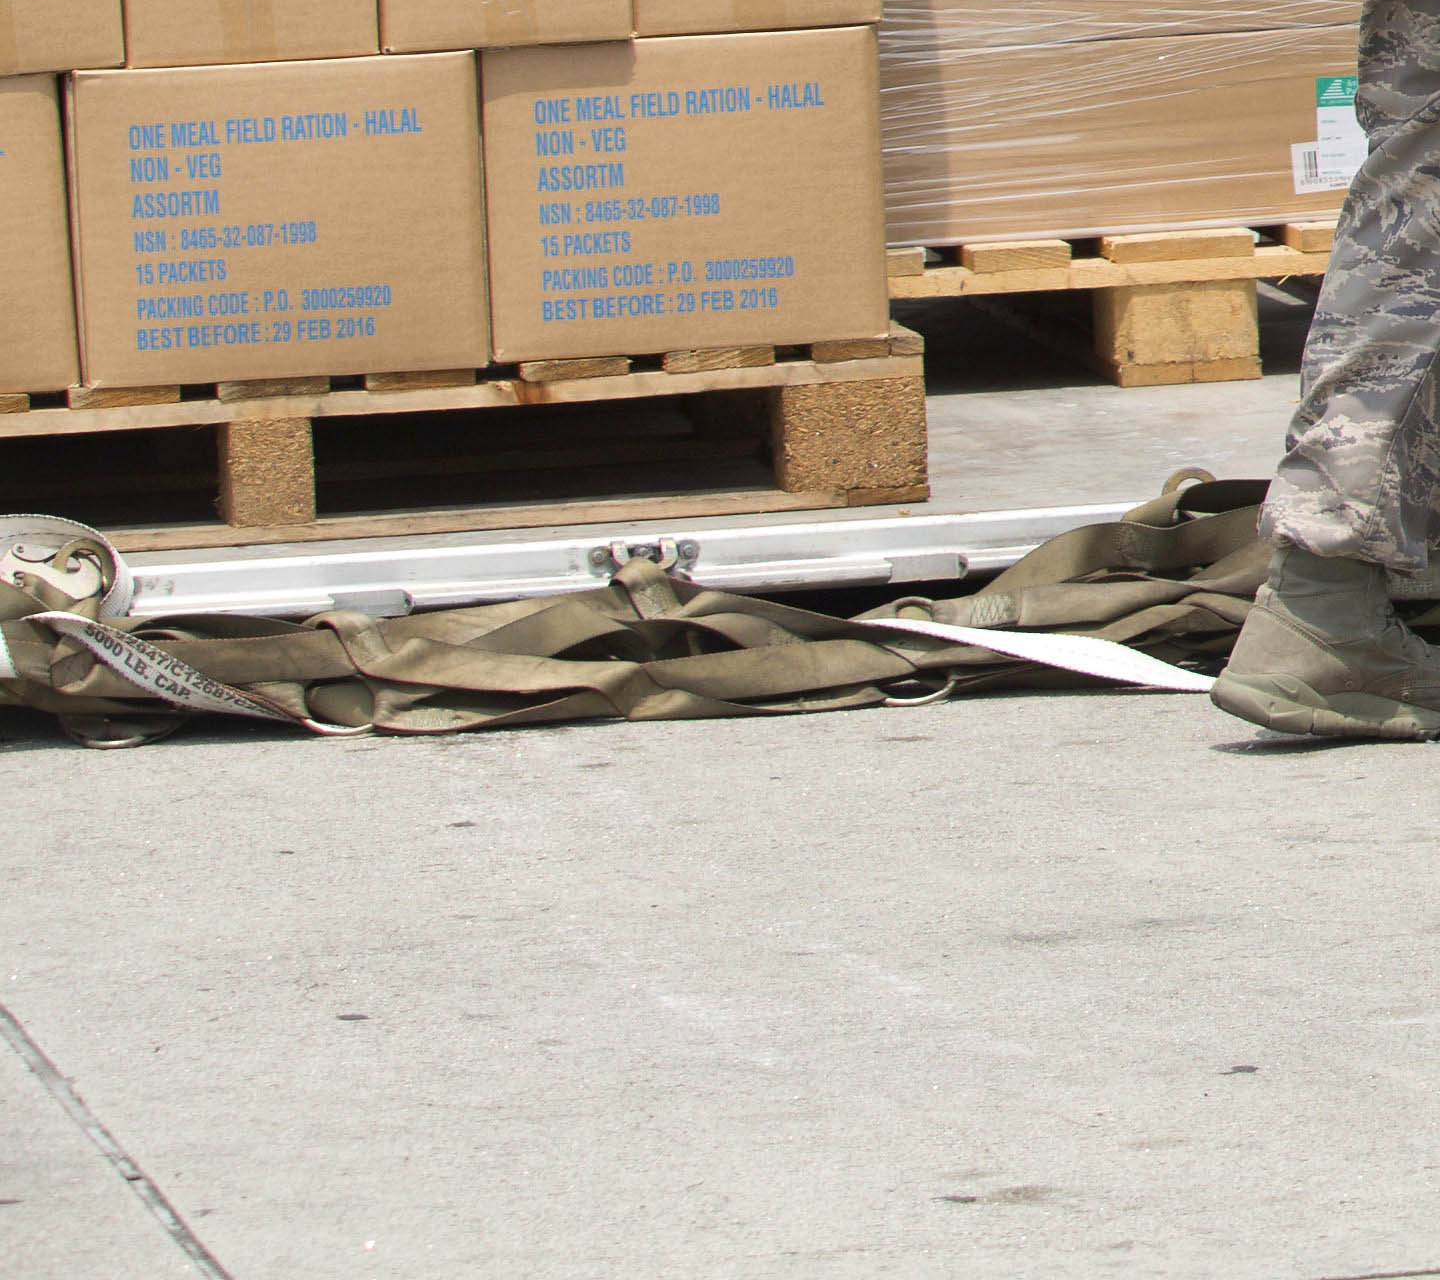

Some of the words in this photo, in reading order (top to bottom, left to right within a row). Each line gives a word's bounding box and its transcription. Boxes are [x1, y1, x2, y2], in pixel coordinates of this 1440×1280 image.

[533, 98, 571, 125] ONE
[574, 95, 626, 121] MEAL
[629, 91, 679, 118] FIELD
[683, 87, 750, 115] RATION
[766, 83, 825, 109] HALAL
[128, 123, 166, 151] ONE
[170, 121, 222, 148] MEAL
[225, 116, 276, 145] FIELD
[279, 112, 347, 141] RATION
[363, 108, 423, 135] HALAL
[535, 130, 575, 156] NON
[591, 126, 628, 153] VEG
[130, 156, 170, 183] NON
[185, 152, 222, 180] VEG
[537, 162, 625, 193] ASSORTM
[132, 189, 220, 219] ASSORTM
[539, 203, 571, 225] NSN
[584, 193, 721, 223] 8465-32-087-1998
[133, 230, 166, 253] NSN
[179, 220, 317, 251] 8465-32-087-1998
[540, 235, 560, 257] 15
[562, 231, 631, 256] PACKETS
[135, 263, 155, 285] 15
[158, 259, 227, 284] PACKETS
[542, 266, 609, 291] PACKING
[612, 263, 655, 288] CODE
[704, 255, 795, 282] 3000259920
[136, 294, 204, 321] PACKING
[207, 291, 250, 316] CODE
[300, 284, 392, 311] 3000259920
[541, 298, 588, 322] BEST
[699, 289, 735, 312] FEB
[737, 287, 778, 310] 2016
[136, 327, 184, 351] BEST
[296, 318, 332, 341] FEB
[335, 316, 376, 339] 2016
[84, 622, 124, 658] 5000
[123, 647, 150, 680] LB.
[154, 671, 193, 700] CAP.
